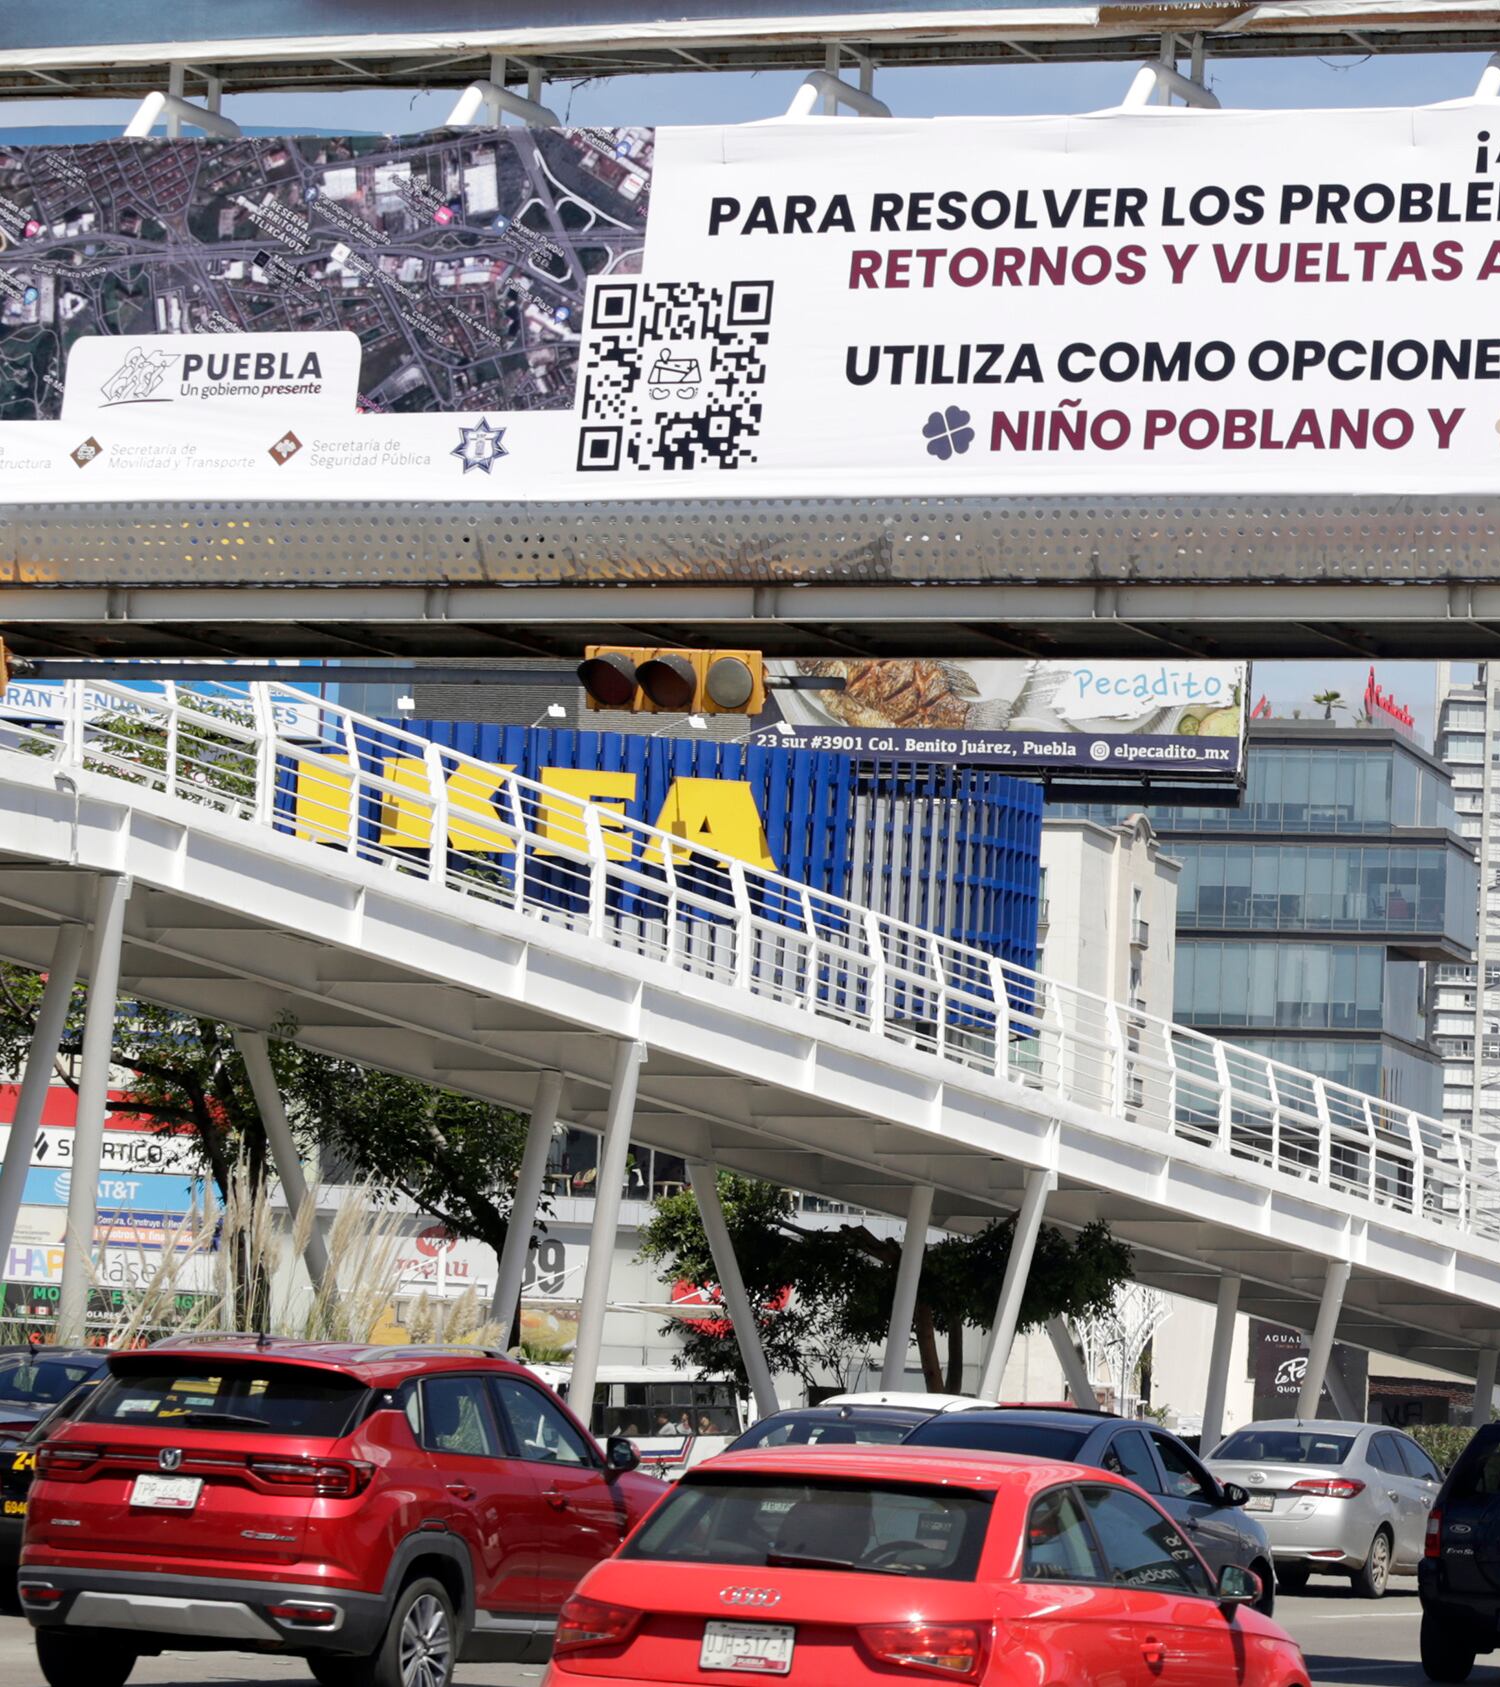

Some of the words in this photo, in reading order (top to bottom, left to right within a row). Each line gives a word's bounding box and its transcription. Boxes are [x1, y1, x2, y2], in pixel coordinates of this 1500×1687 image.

[258, 204, 312, 245] TERRITORIAL
[270, 201, 309, 230] RESERVA
[708, 195, 855, 236] PARA
[870, 187, 1148, 231] RESOLVER
[1161, 185, 1265, 227] LOS
[848, 244, 1147, 289] RETORNOS
[1162, 244, 1199, 284] Y
[1212, 240, 1464, 283] VUELTAS
[182, 351, 322, 381] PUEBLA
[845, 343, 1044, 386] UTILIZA
[1057, 340, 1236, 383] COMO
[180, 383, 200, 396] Un
[201, 382, 260, 399] gobierno
[261, 382, 322, 397] presente
[990, 397, 1131, 452] NIÑO
[1143, 407, 1414, 451] POBLANO
[1428, 407, 1466, 449] Y
[111, 443, 177, 456] Secretaría
[182, 443, 197, 455] de
[310, 454, 377, 467] Seguridad
[382, 453, 431, 466] Pública
[312, 440, 379, 452] Secretaría
[385, 439, 401, 451] de
[107, 457, 172, 469] Movilidad
[173, 459, 182, 471] y
[186, 457, 256, 471] Transporte
[1073, 668, 1222, 698] Pecadito
[757, 734, 778, 748] 23
[781, 736, 807, 750] sur
[811, 734, 863, 752] #3901
[868, 735, 899, 752] Col.
[905, 738, 957, 755] Benito
[959, 739, 1017, 759] Juárez,
[1023, 740, 1077, 757] Puebla
[1114, 742, 1229, 762] elpecadito_mx
[296, 753, 777, 871] IKEA
